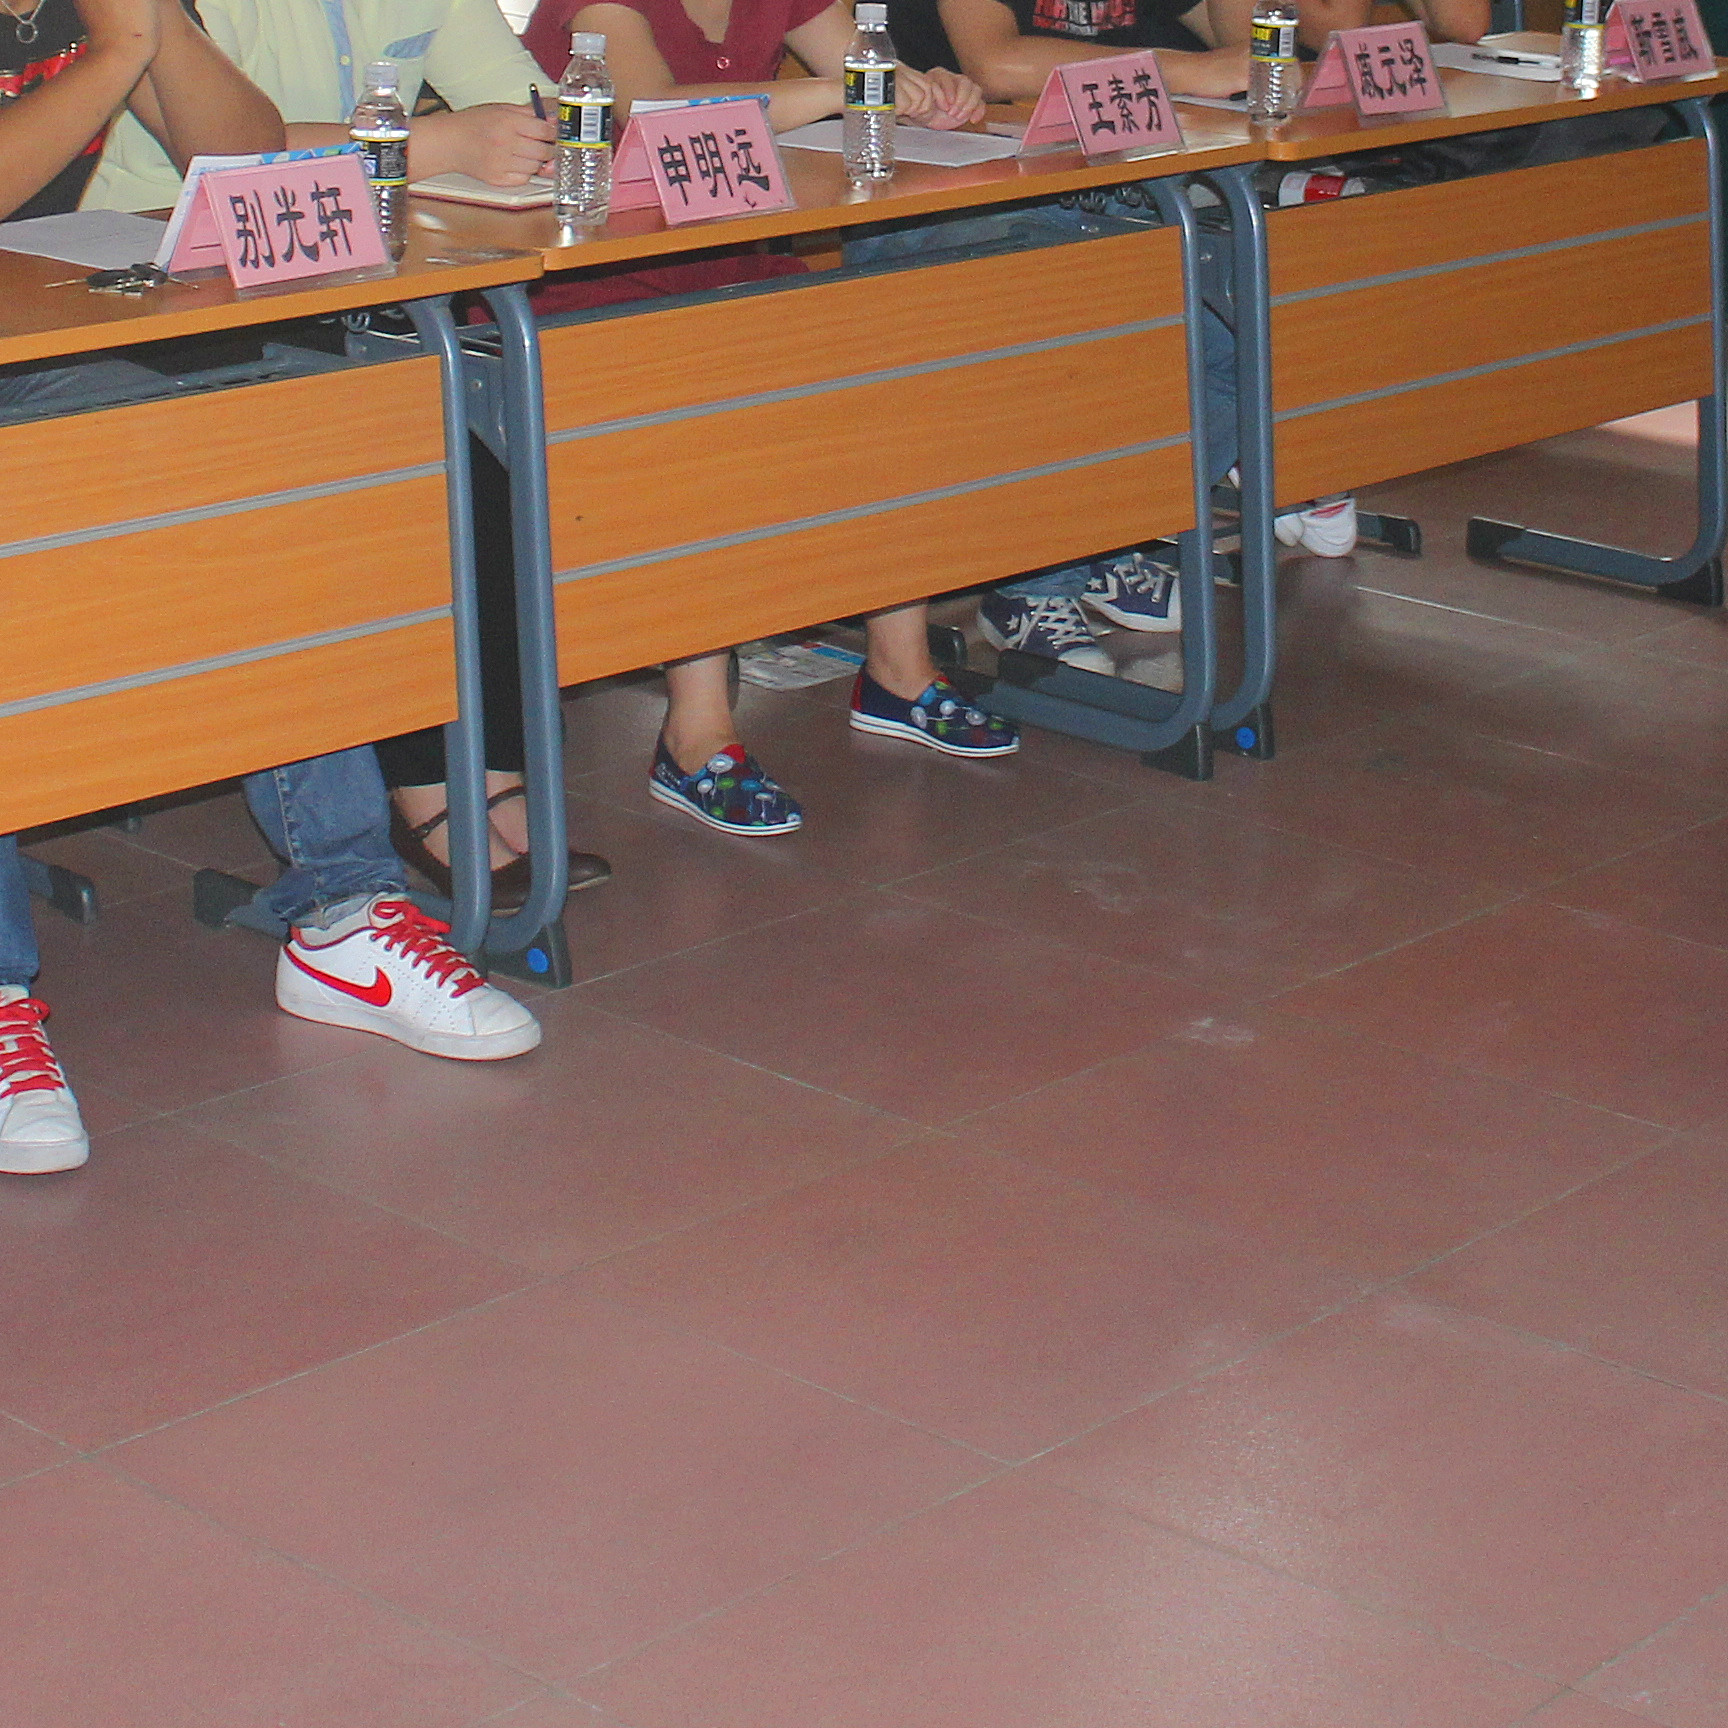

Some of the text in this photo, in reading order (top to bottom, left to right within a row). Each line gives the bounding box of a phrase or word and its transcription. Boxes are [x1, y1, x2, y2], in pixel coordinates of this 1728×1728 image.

[1082, 69, 1162, 135] 王素芳
[658, 129, 769, 207] 申明远
[230, 181, 352, 268] 别光轩
